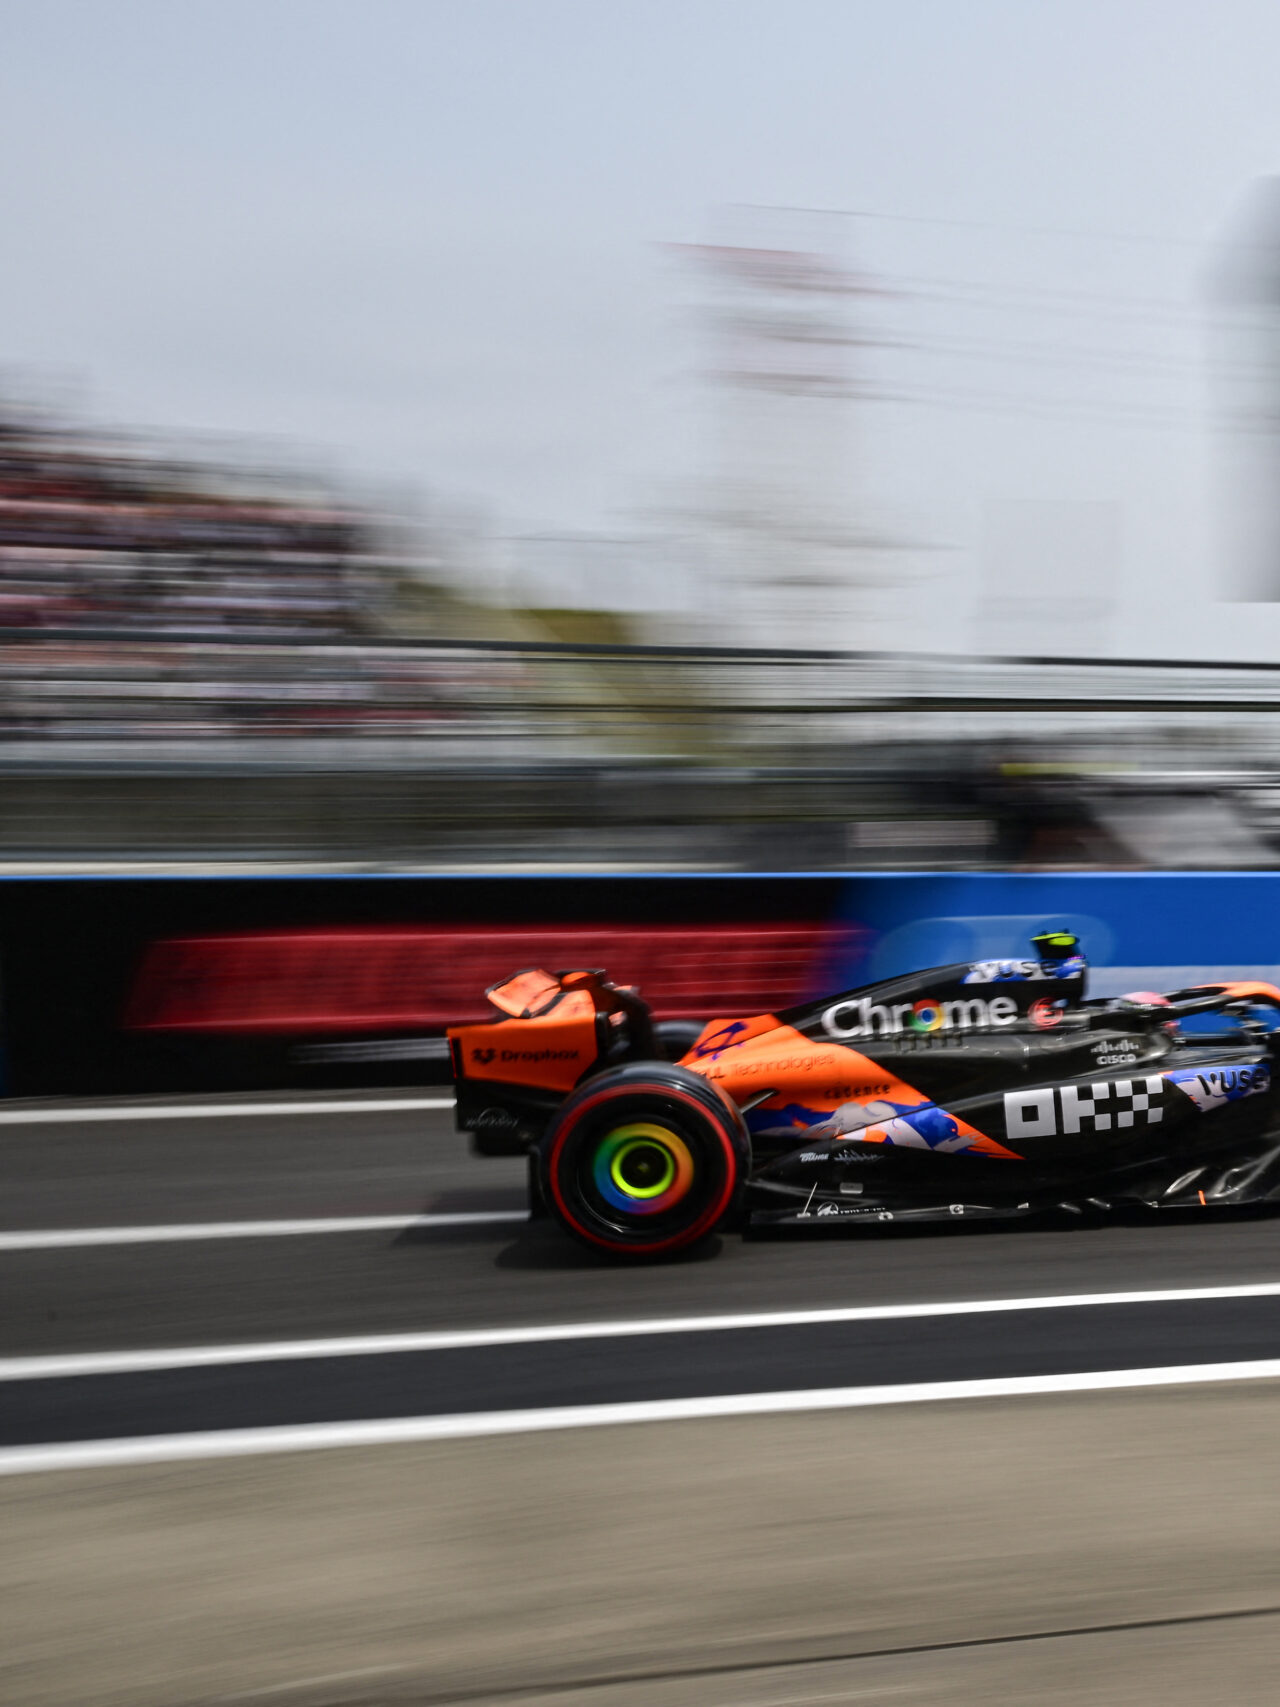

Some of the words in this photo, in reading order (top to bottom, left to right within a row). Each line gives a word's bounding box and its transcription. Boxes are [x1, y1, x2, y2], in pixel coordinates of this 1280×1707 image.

[821, 997, 1018, 1038] Chrome
[501, 1048, 579, 1063] Dropbox
[731, 1053, 836, 1076] Technologies
[1096, 1054, 1137, 1065] cisco
[1004, 1075, 1164, 1139] OKX
